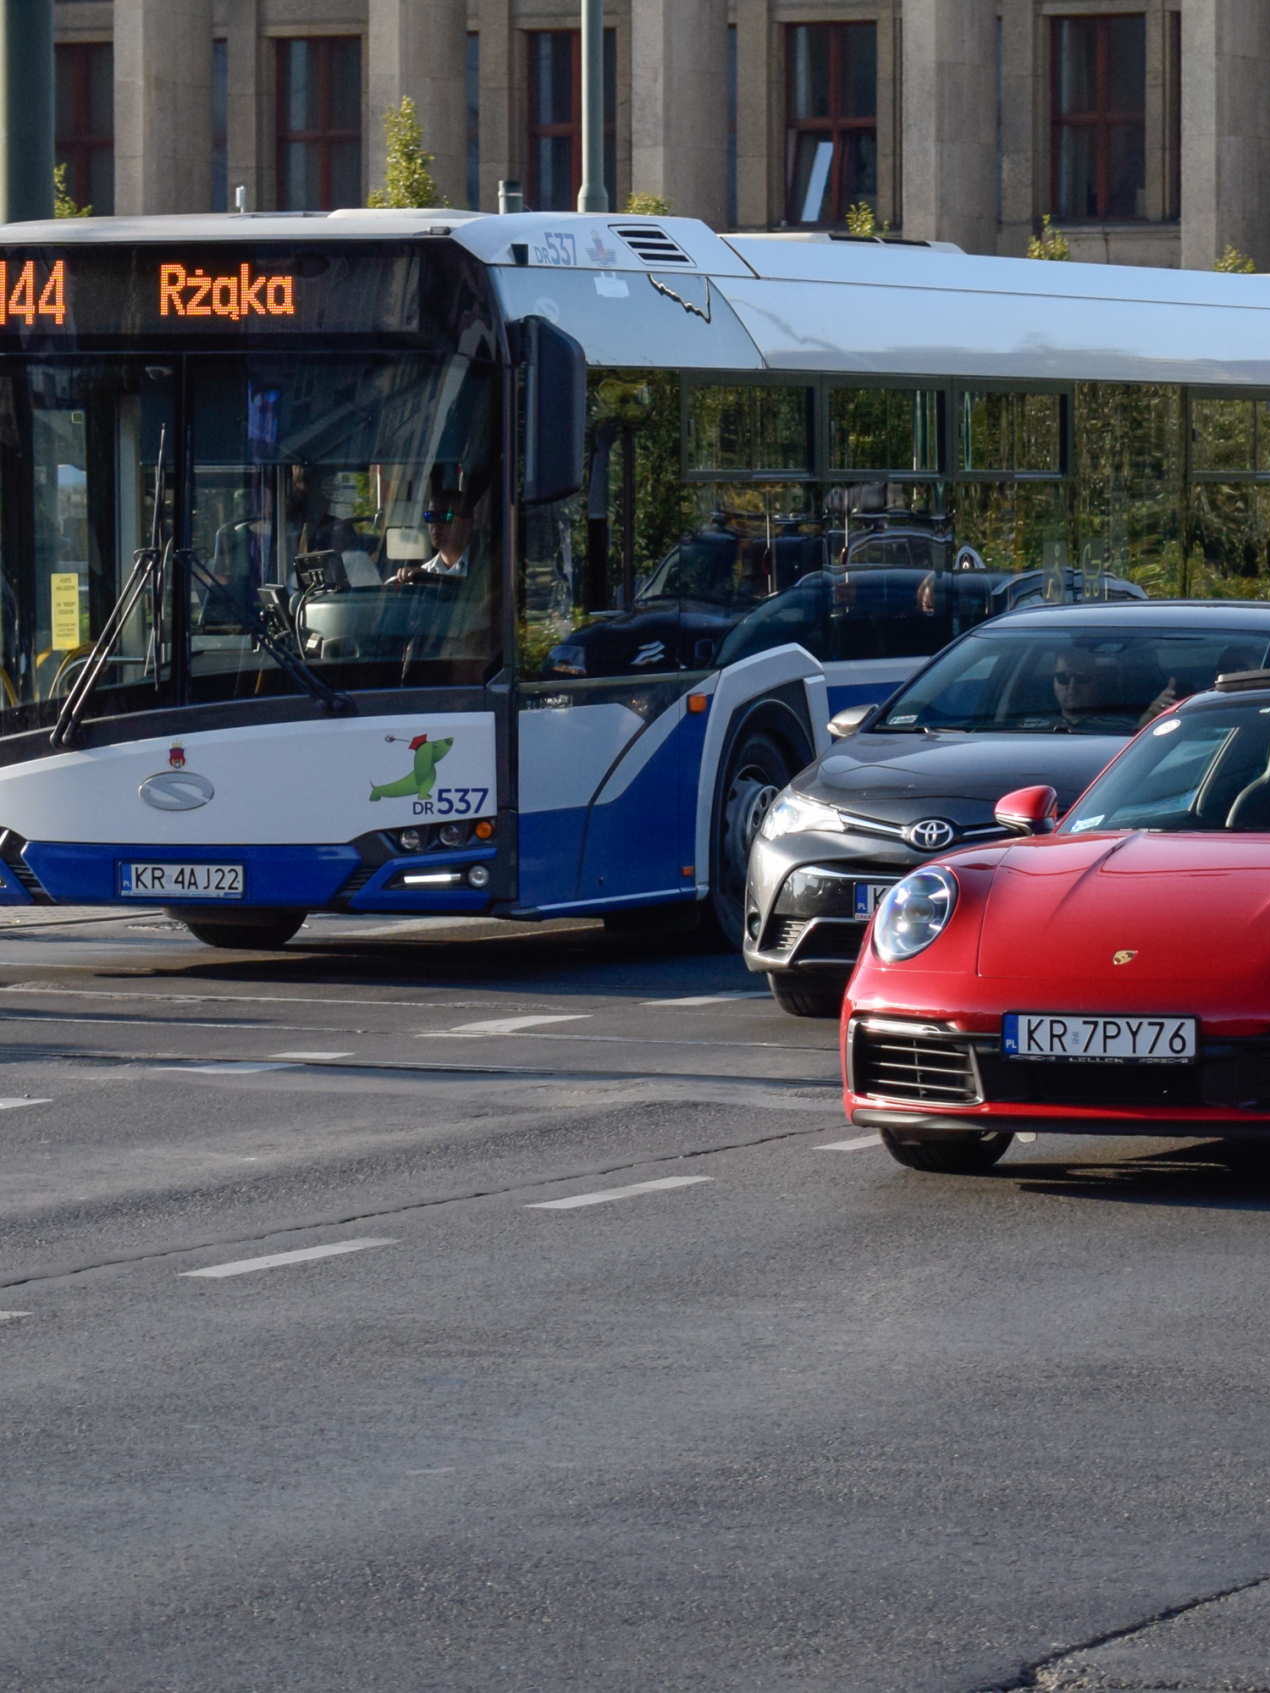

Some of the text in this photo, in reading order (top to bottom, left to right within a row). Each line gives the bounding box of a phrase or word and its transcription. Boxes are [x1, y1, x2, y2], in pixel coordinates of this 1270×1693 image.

[160, 263, 294, 320] Rżąka
[135, 866, 165, 889] KR
[173, 867, 239, 891] 4AJ22
[857, 902, 867, 910] PL
[1006, 1018, 1187, 1055] PL KR 7PY76
